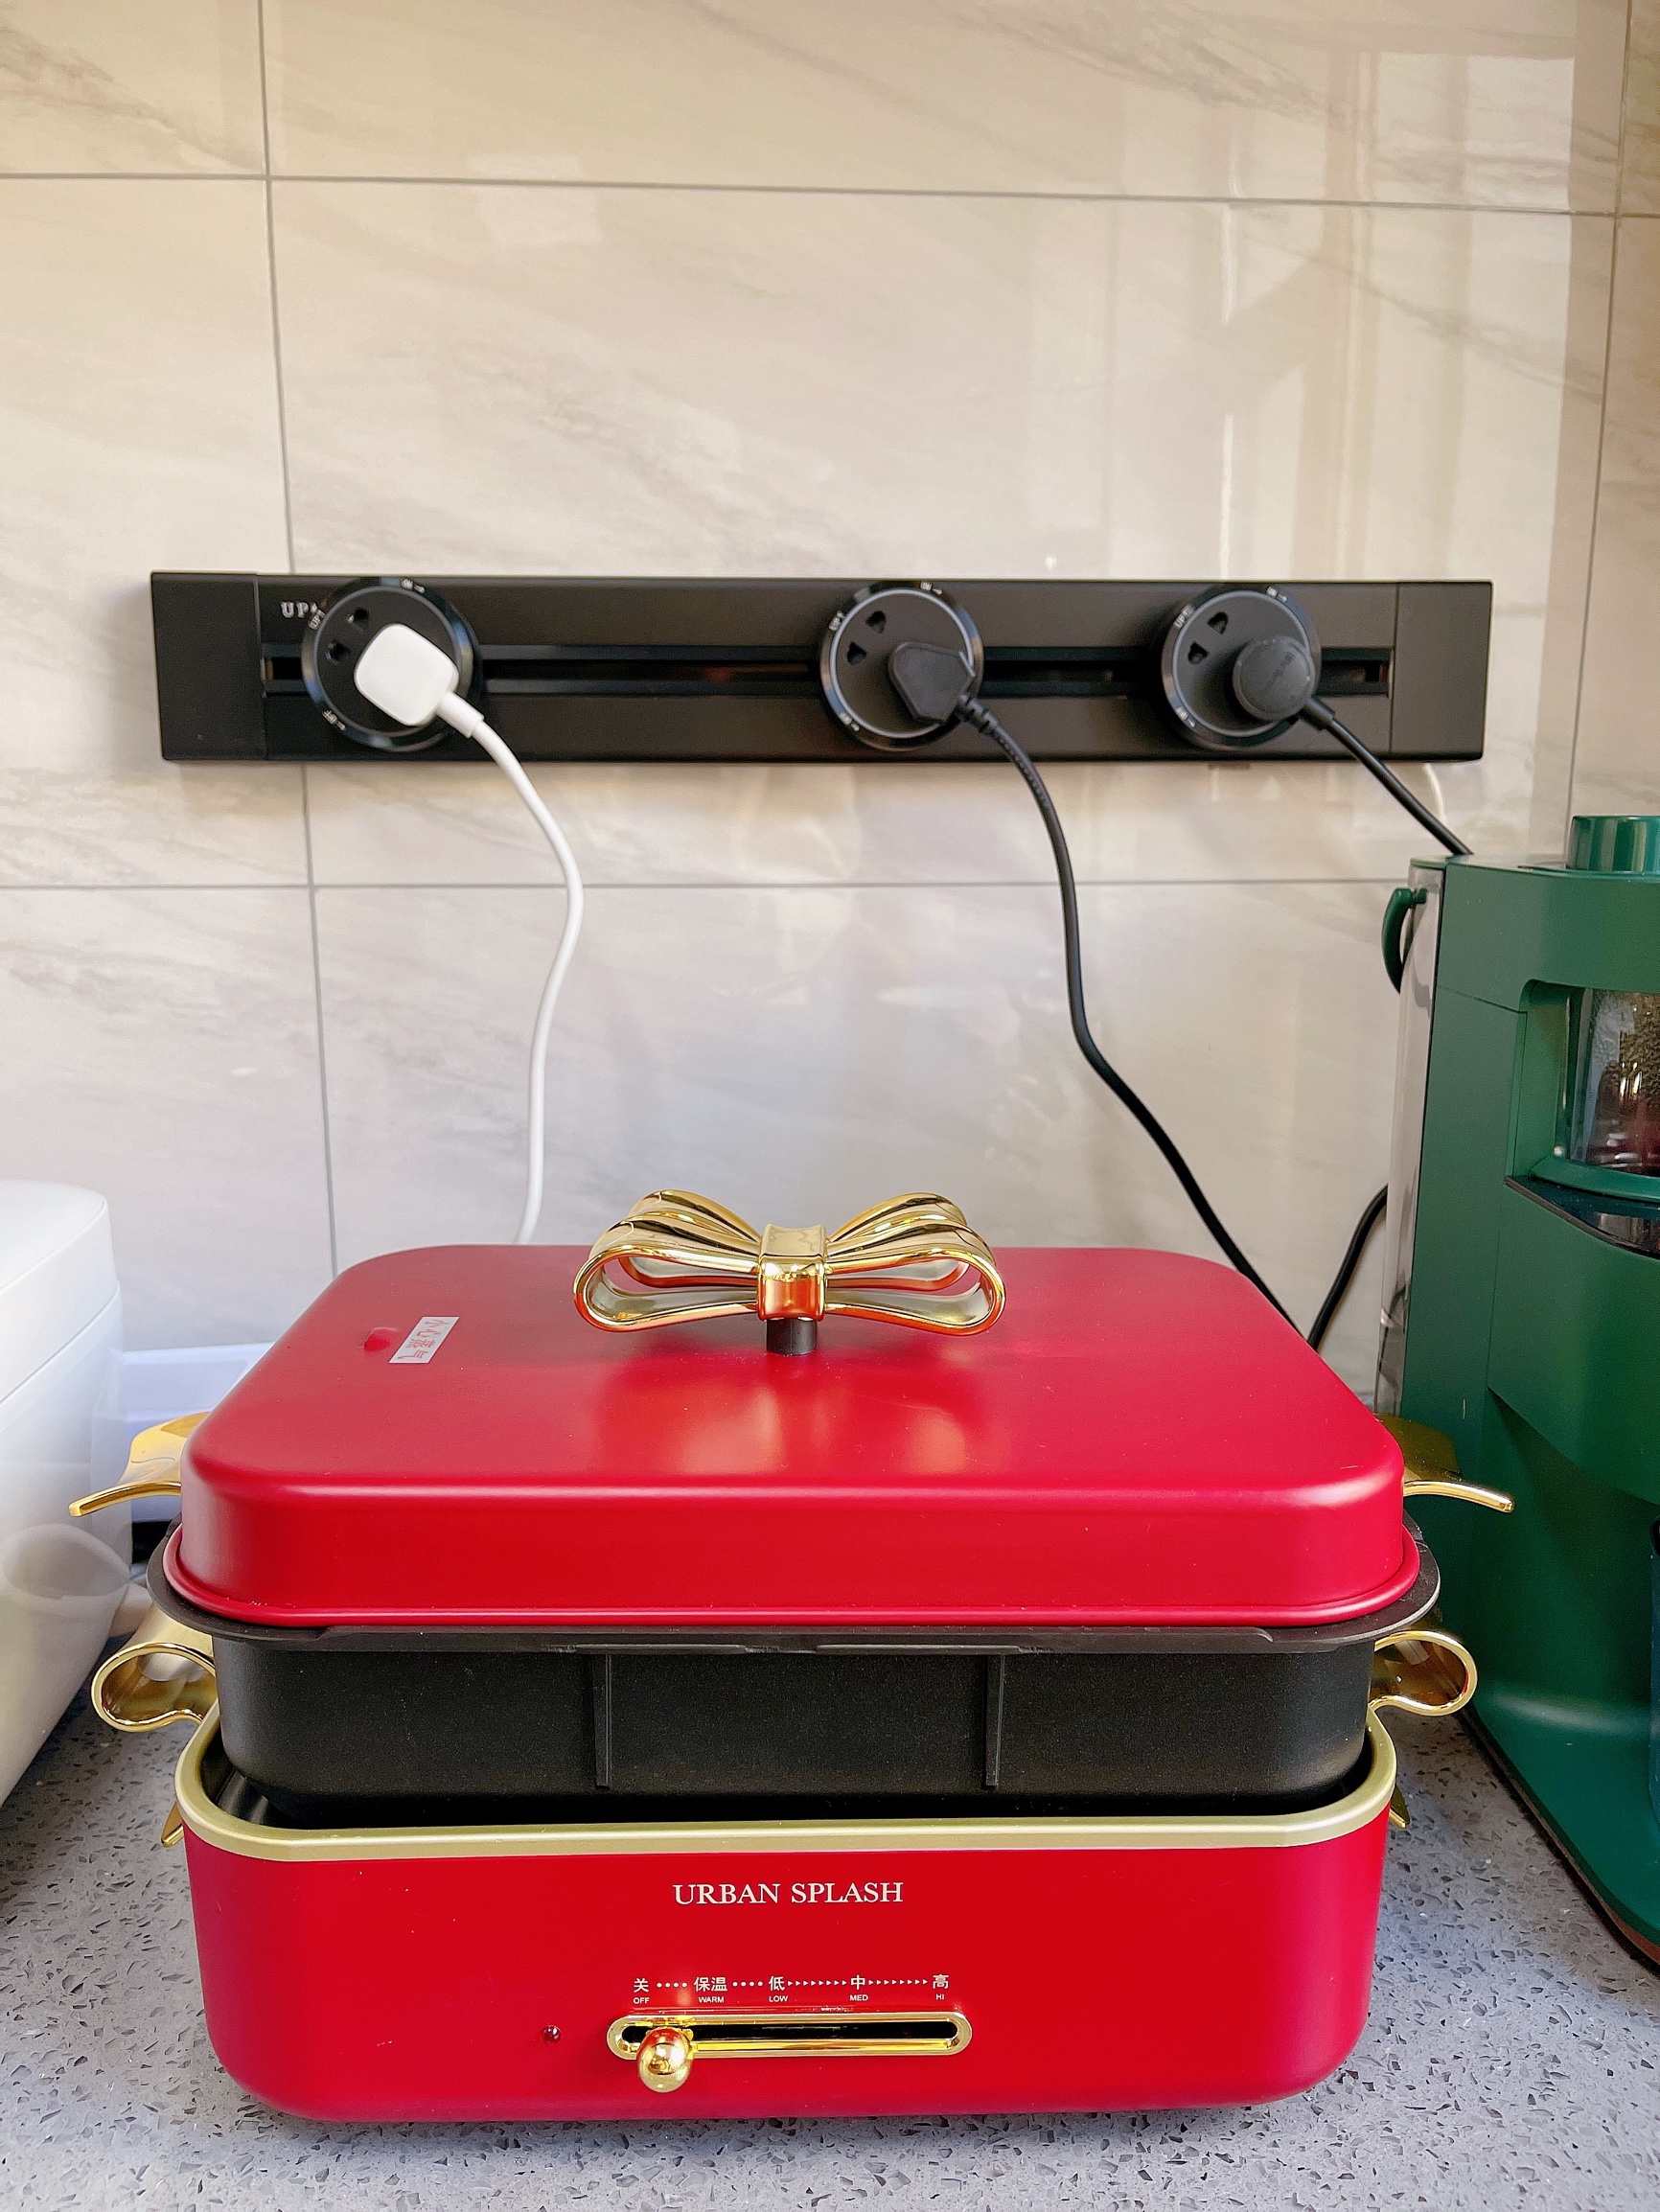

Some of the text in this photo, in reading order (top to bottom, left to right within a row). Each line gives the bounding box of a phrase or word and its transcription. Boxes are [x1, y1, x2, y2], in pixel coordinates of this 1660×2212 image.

[673, 1881, 904, 1905] URBAN SPLASH
[633, 1973, 950, 1993] 关 保温 低 中 高
[633, 1993, 945, 2005] OFF WARM LOW MED HI
